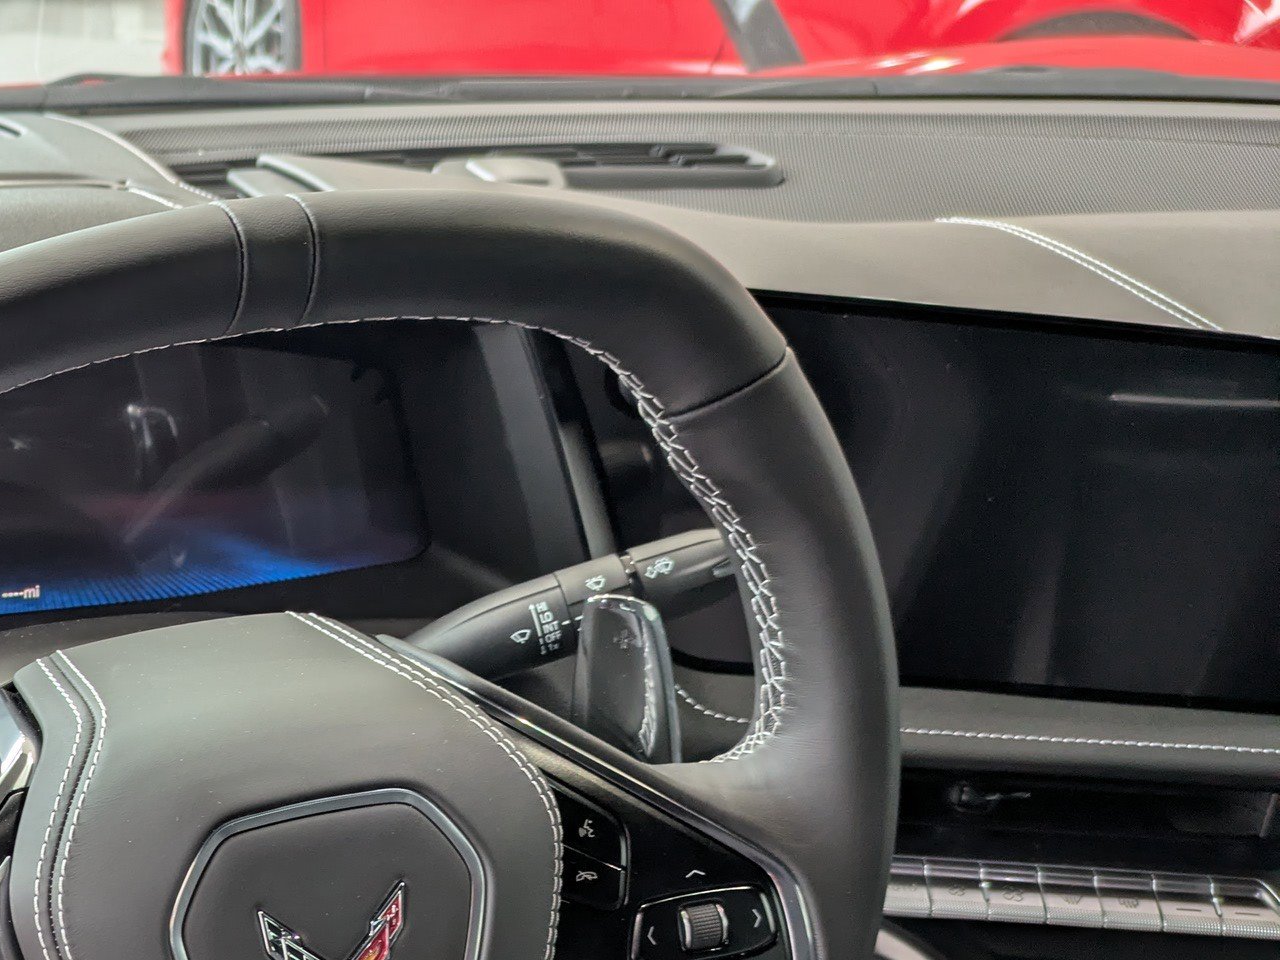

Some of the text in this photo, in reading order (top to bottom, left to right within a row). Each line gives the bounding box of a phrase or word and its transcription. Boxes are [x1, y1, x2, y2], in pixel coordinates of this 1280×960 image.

[539, 611, 554, 624] LO
[542, 620, 560, 634] INT
[544, 630, 562, 643] OFF
